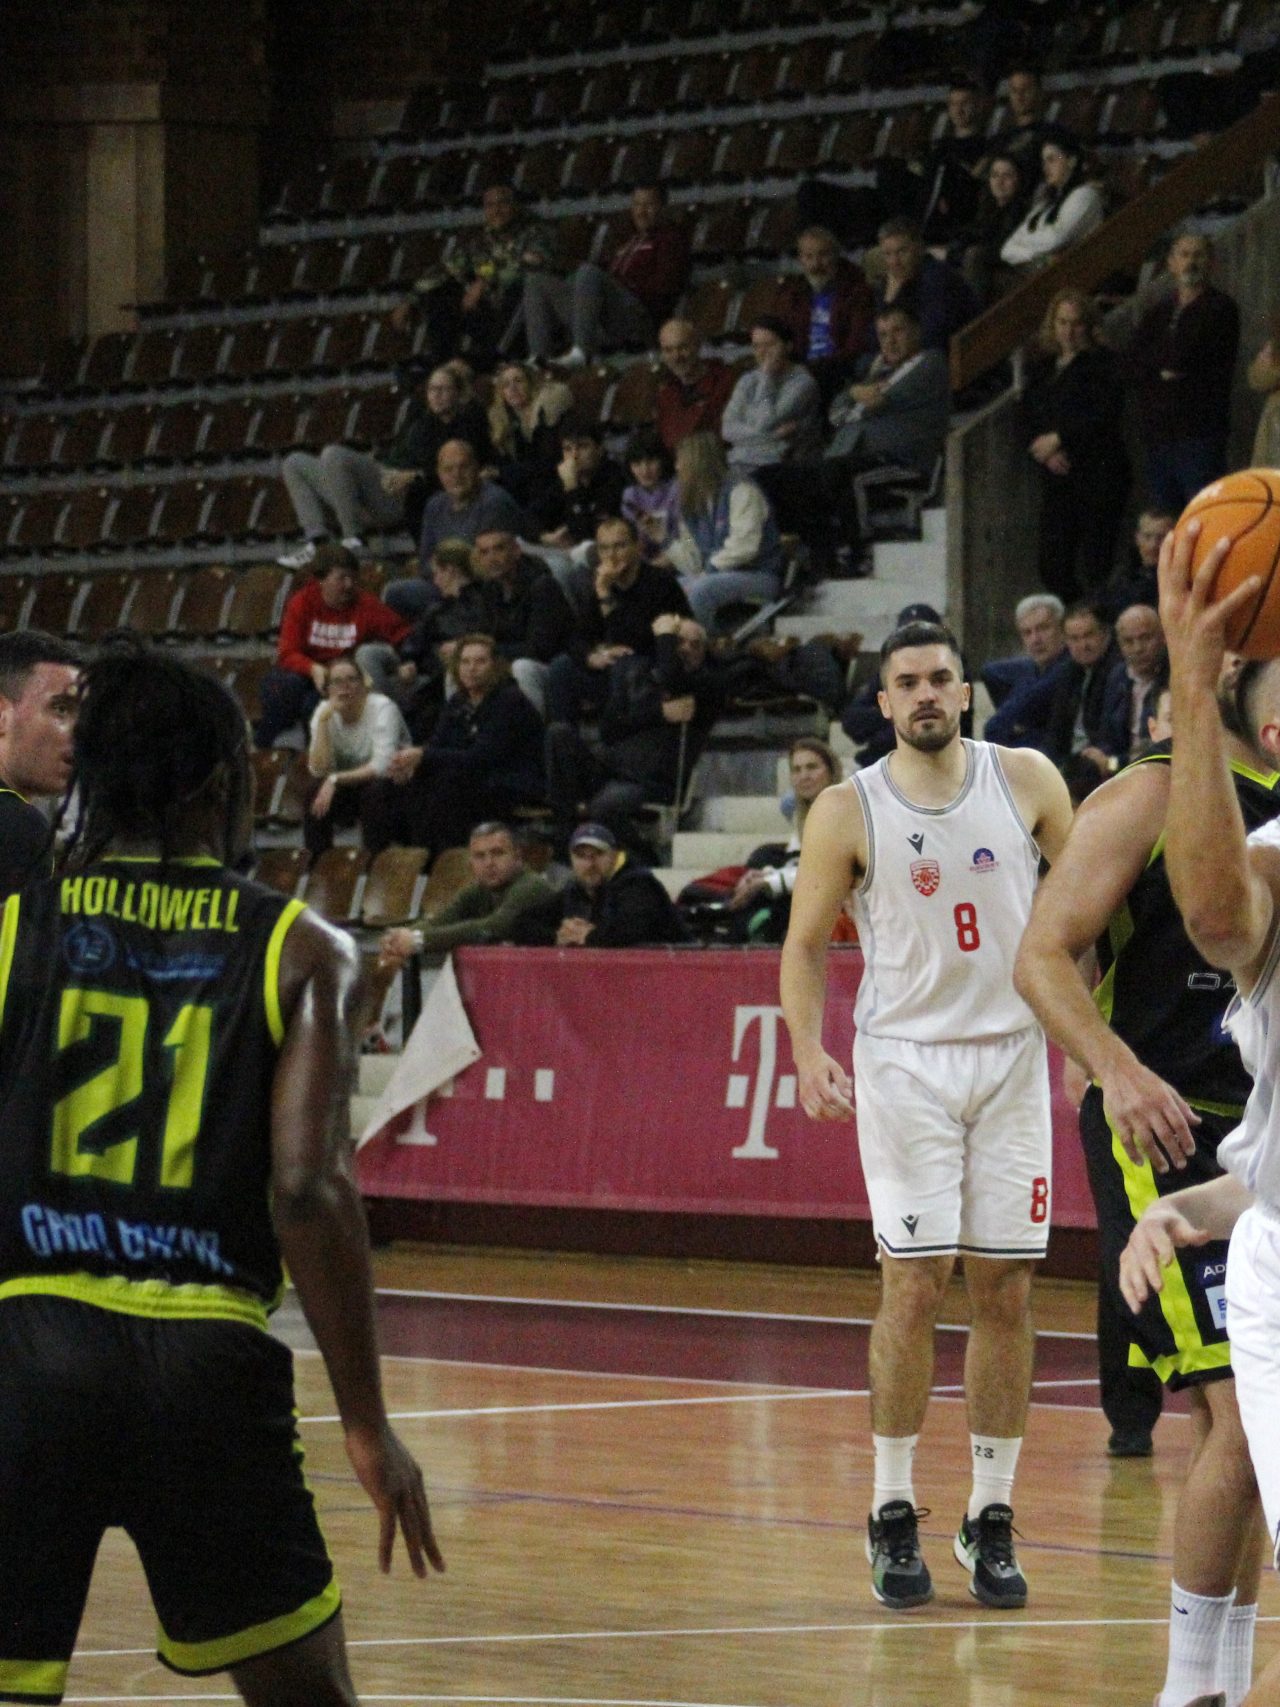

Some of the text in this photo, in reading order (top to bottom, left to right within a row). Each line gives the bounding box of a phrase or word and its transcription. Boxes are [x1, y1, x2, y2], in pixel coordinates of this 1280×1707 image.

[60, 876, 240, 933] HOLLOWELL
[953, 902, 980, 952] 8
[52, 988, 213, 1188] 21
[1031, 1177, 1048, 1223] 8
[1203, 1264, 1228, 1279] AD
